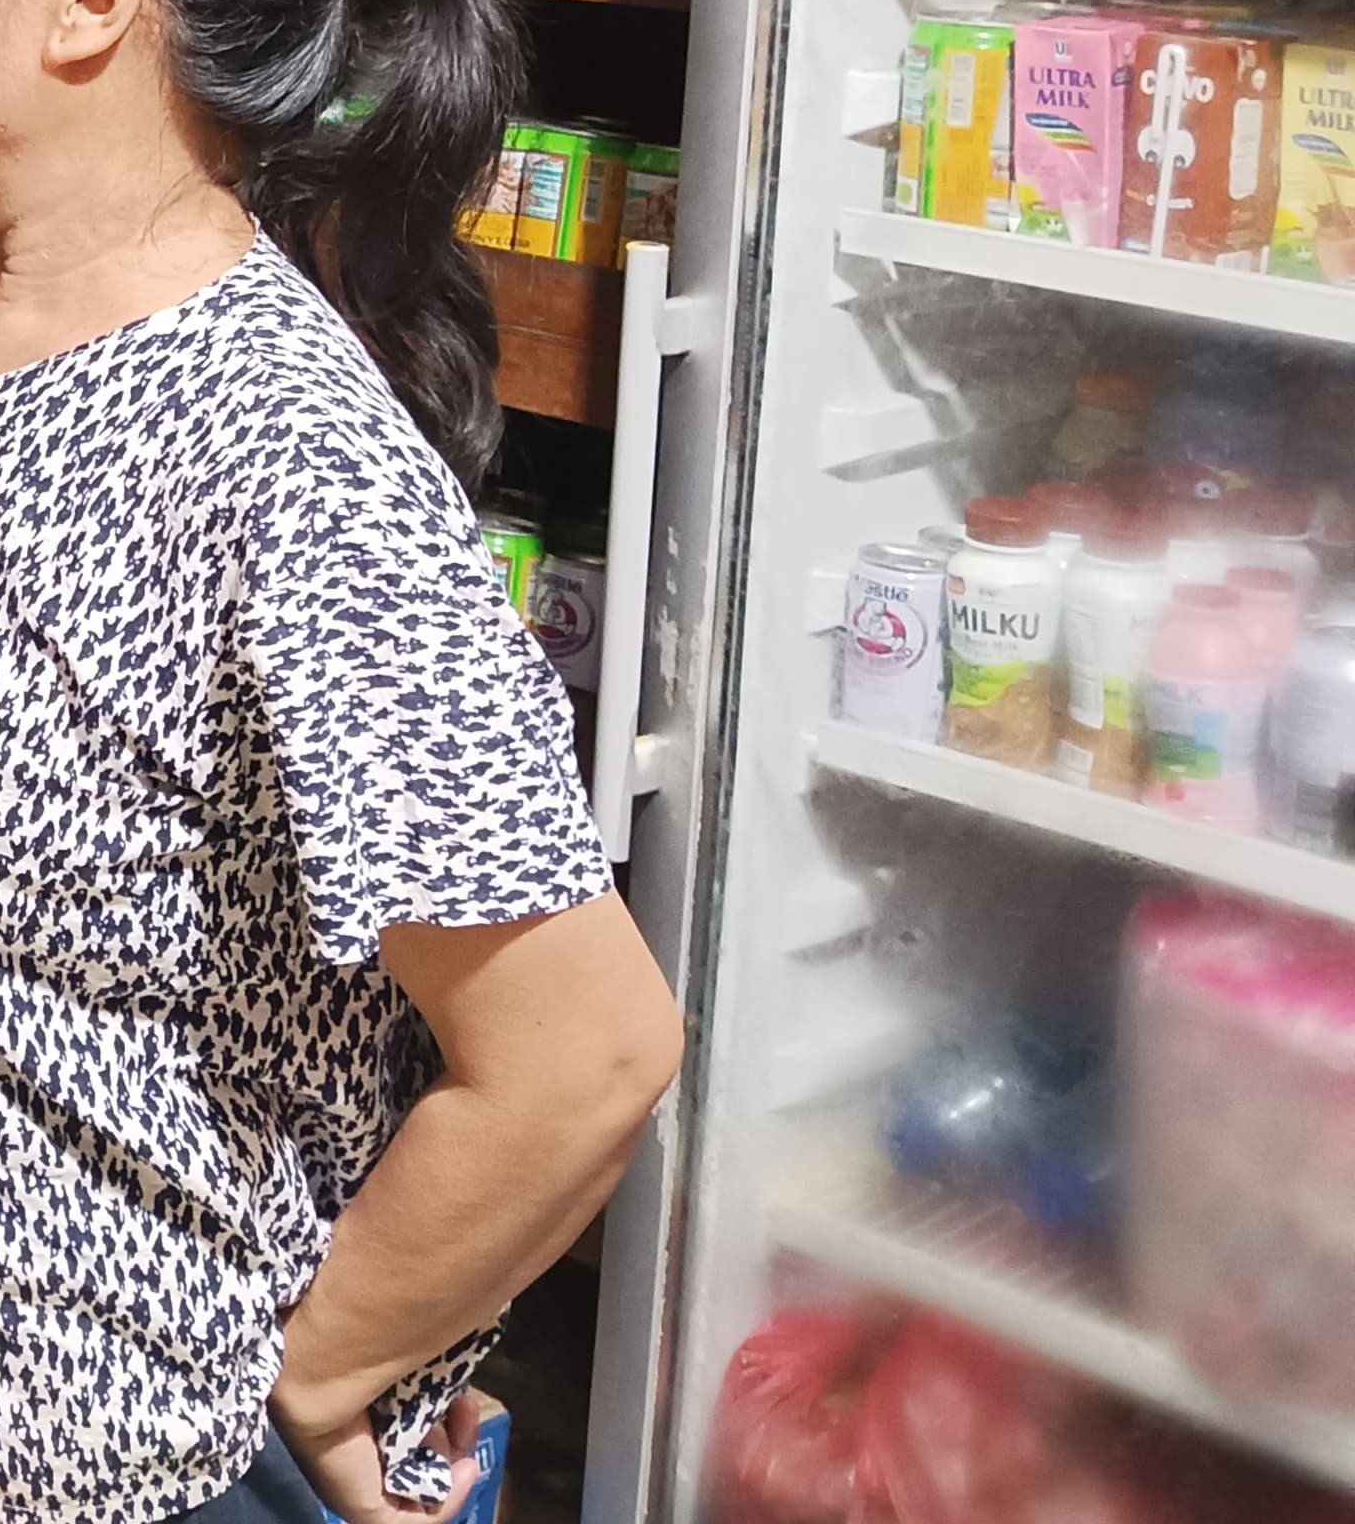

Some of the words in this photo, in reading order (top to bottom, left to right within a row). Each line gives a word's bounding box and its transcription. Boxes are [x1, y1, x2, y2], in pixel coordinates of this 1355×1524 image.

[1028, 65, 1096, 88] ULTRA
[1036, 88, 1090, 109] MILK
[1298, 86, 1355, 108] ULTR
[951, 600, 1042, 641] MILKU
